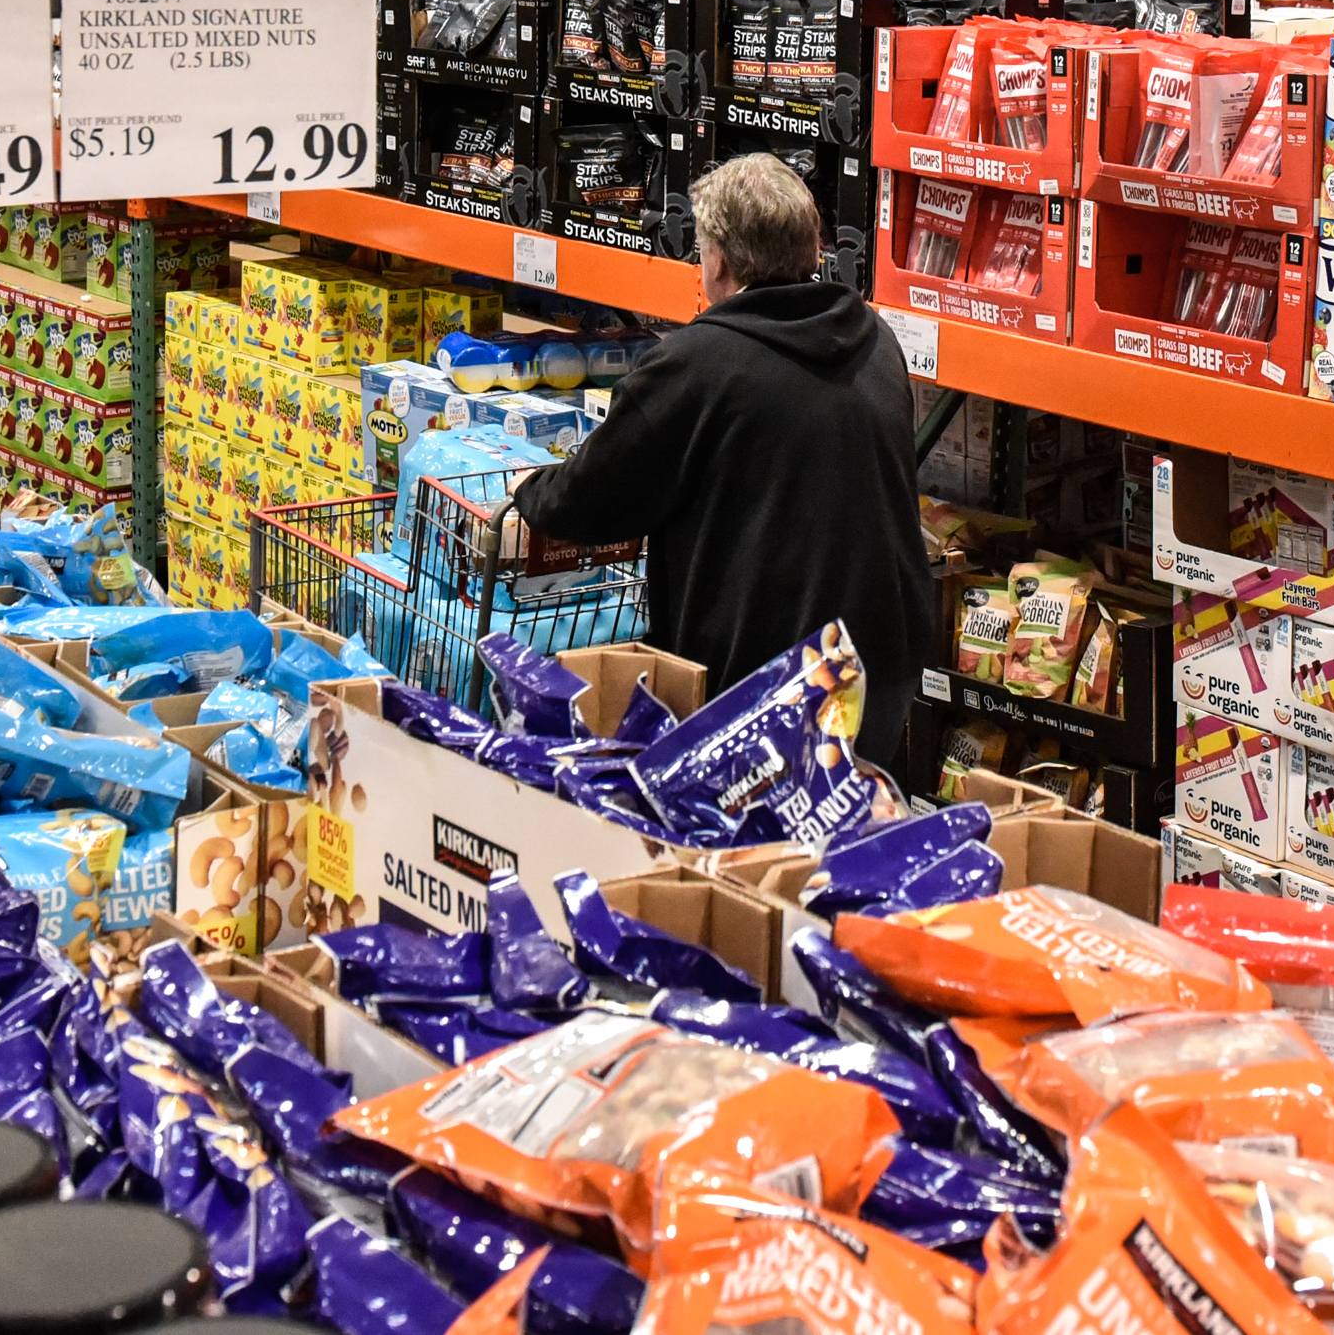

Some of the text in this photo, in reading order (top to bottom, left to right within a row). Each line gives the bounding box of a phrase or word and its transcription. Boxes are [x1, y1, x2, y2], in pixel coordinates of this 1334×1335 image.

[79, 8, 303, 27] KIRKLAND SIGNATURE
[80, 29, 316, 49] UNSALTED MIXED NUTS
[78, 51, 250, 72] 40 OZ (2.5 LBS)
[446, 59, 527, 81] AMERICAN WAGYU
[998, 66, 1046, 94] CHOMPS
[570, 82, 653, 110] STEAK STRIPS
[728, 104, 819, 137] STEAK STRIPS
[69, 126, 155, 161] $5.19
[212, 123, 368, 185] 12.99
[912, 150, 940, 169] CHOMPS
[976, 157, 1005, 182] BEEF
[371, 417, 403, 438] MOTT'S
[1176, 552, 1200, 566] pure
[1176, 564, 1215, 583] organic
[319, 814, 347, 854] 85%
[384, 852, 451, 916] SALTED
